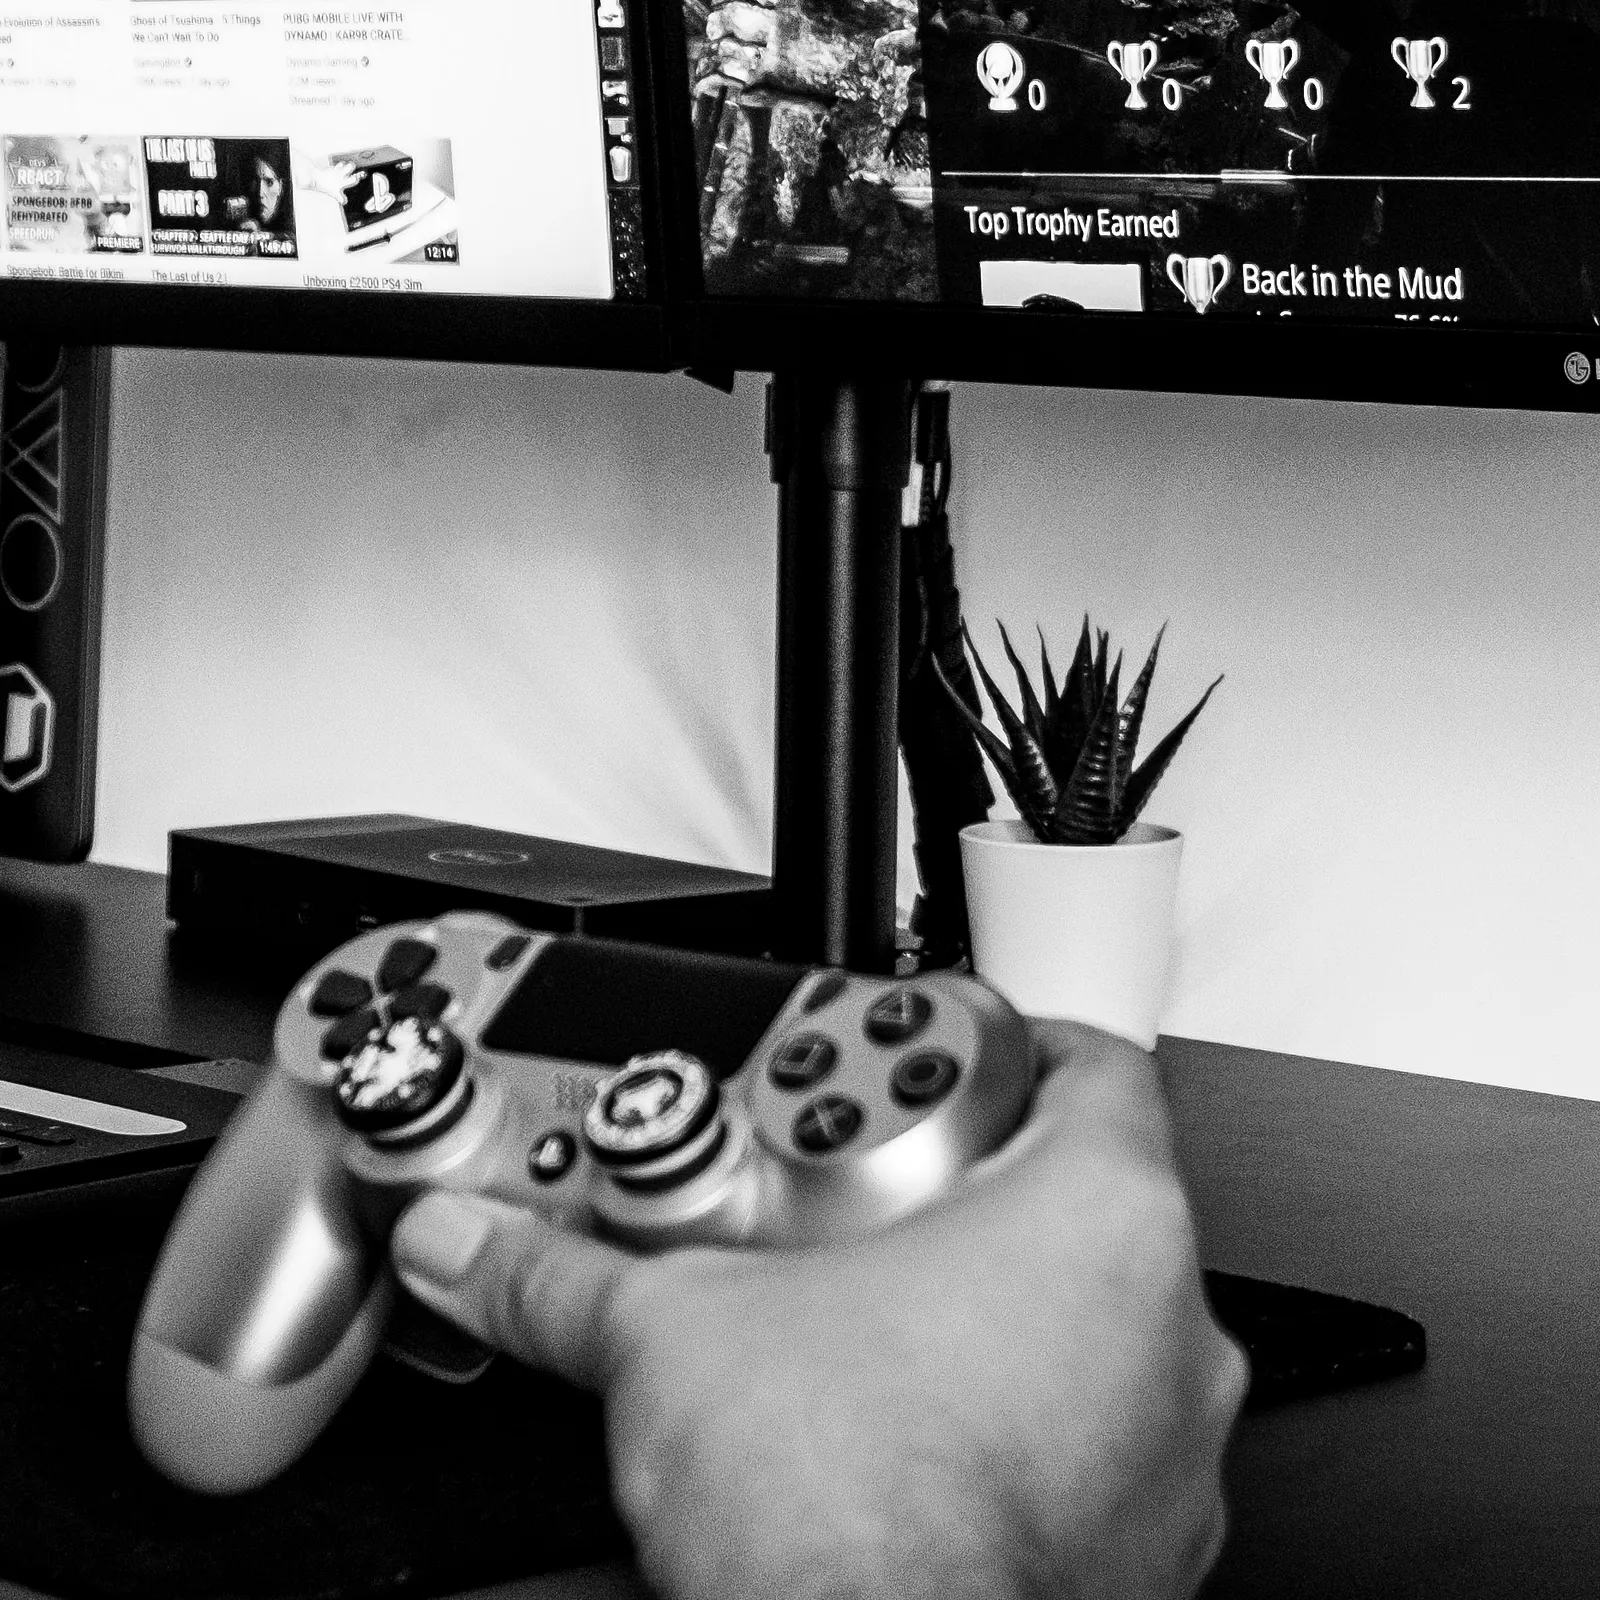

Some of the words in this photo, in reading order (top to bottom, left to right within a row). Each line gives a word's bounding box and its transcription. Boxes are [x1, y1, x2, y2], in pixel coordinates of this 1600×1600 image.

[231, 13, 262, 27] Things
[283, 12, 310, 25] PUBG
[312, 12, 350, 24] MOBILE
[352, 11, 375, 24] LIVE
[376, 11, 404, 24] WITH
[131, 32, 146, 43] We
[207, 32, 220, 43] Do
[284, 30, 328, 42] DYNAMO
[1027, 78, 1046, 112] 0
[1162, 78, 1182, 111] 0
[1303, 78, 1324, 111] 0
[1451, 78, 1471, 111] 2
[16, 167, 64, 187] REACT
[158, 190, 195, 217] PART
[195, 190, 210, 218] 3
[11, 210, 69, 223] REHYDRATED
[963, 205, 1010, 240] Top
[1010, 206, 1093, 243] Trophy
[1097, 208, 1180, 238] Earned
[97, 236, 141, 249] PREMIERE
[427, 246, 453, 260] 12:14
[151, 270, 168, 282] The
[169, 271, 190, 283] Last
[191, 271, 200, 283] of
[201, 272, 215, 284] Us
[302, 275, 347, 289] Unboxing
[381, 278, 401, 290] PS4
[403, 279, 423, 291] Sim
[1242, 263, 1307, 298] Back
[1311, 266, 1340, 298] in
[1345, 266, 1392, 299] the
[1399, 267, 1464, 301] Mud
